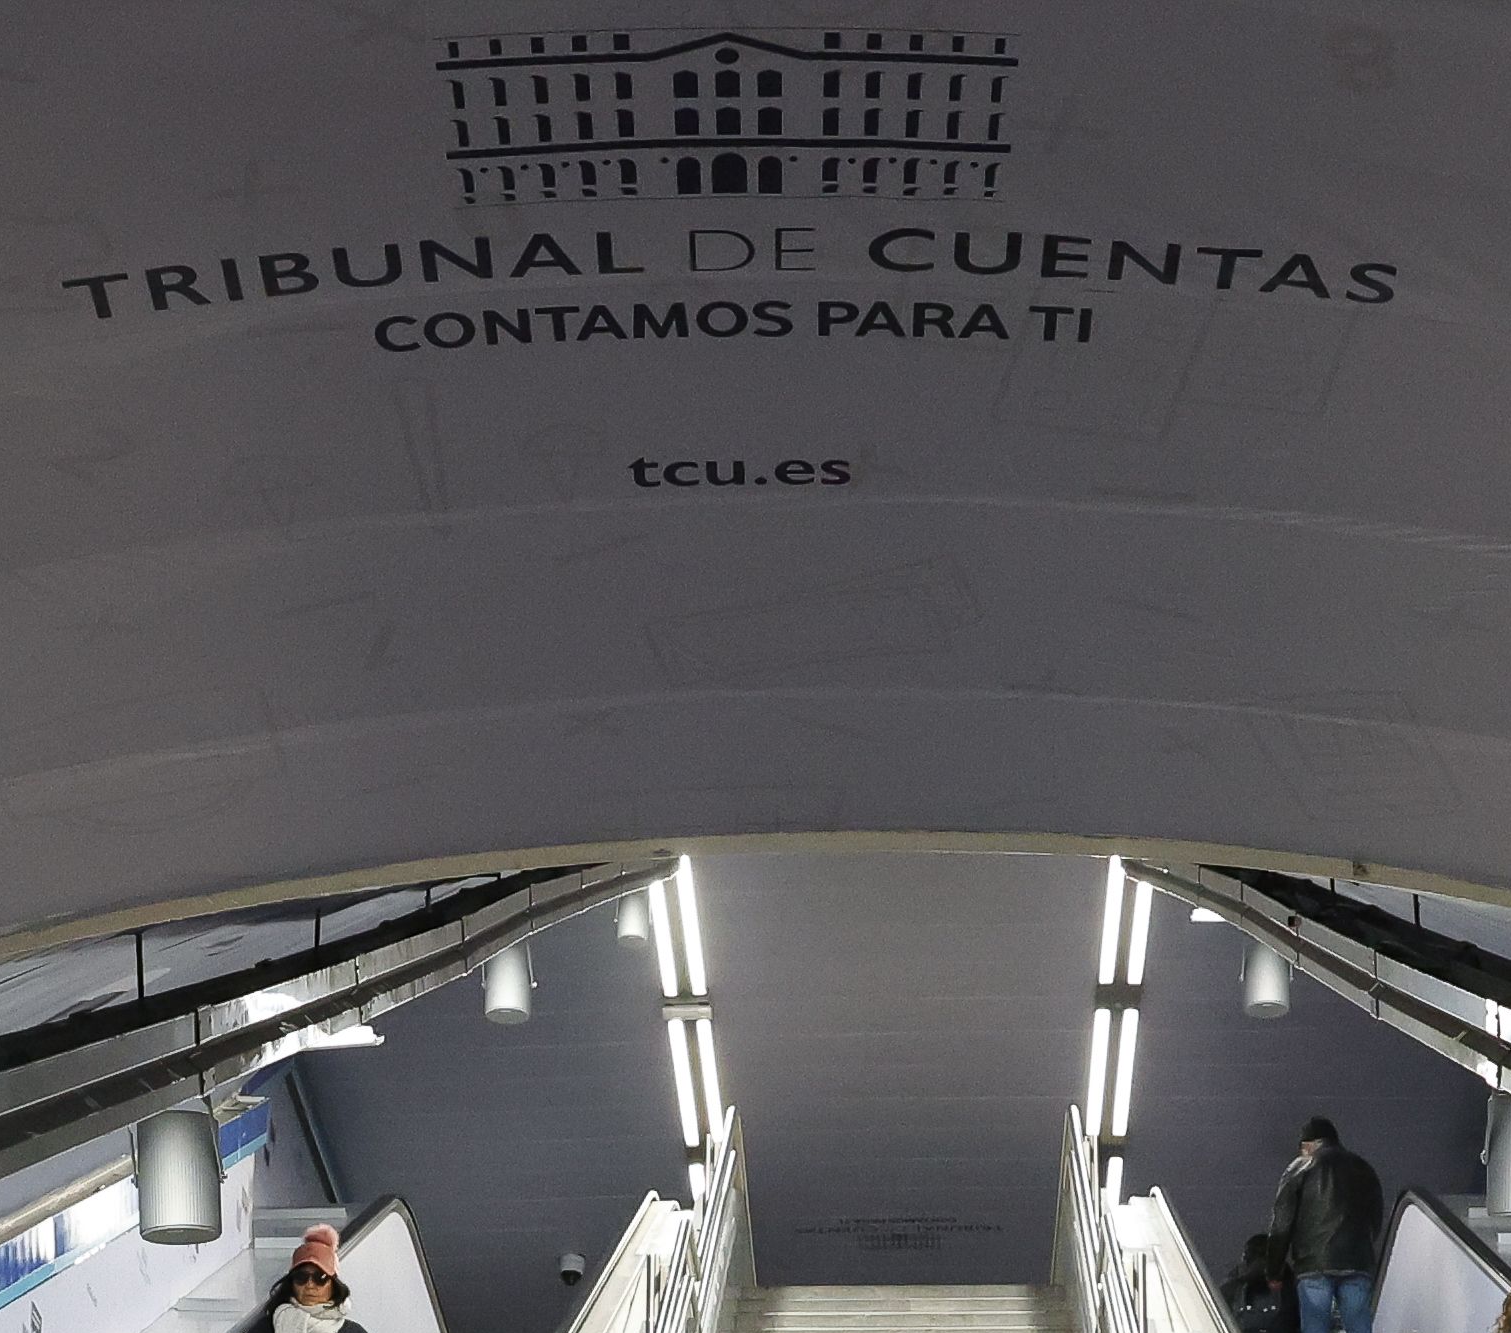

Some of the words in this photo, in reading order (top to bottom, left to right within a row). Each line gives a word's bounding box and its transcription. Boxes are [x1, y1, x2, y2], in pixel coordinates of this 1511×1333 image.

[62, 228, 643, 320] TRIBUNAL
[687, 226, 818, 275] DE
[867, 226, 1399, 305] CUENTAS
[374, 302, 793, 354] CONTAMOS
[816, 300, 1010, 342] PARA
[1030, 304, 1095, 345] TI
[627, 452, 853, 490] tcu.es
